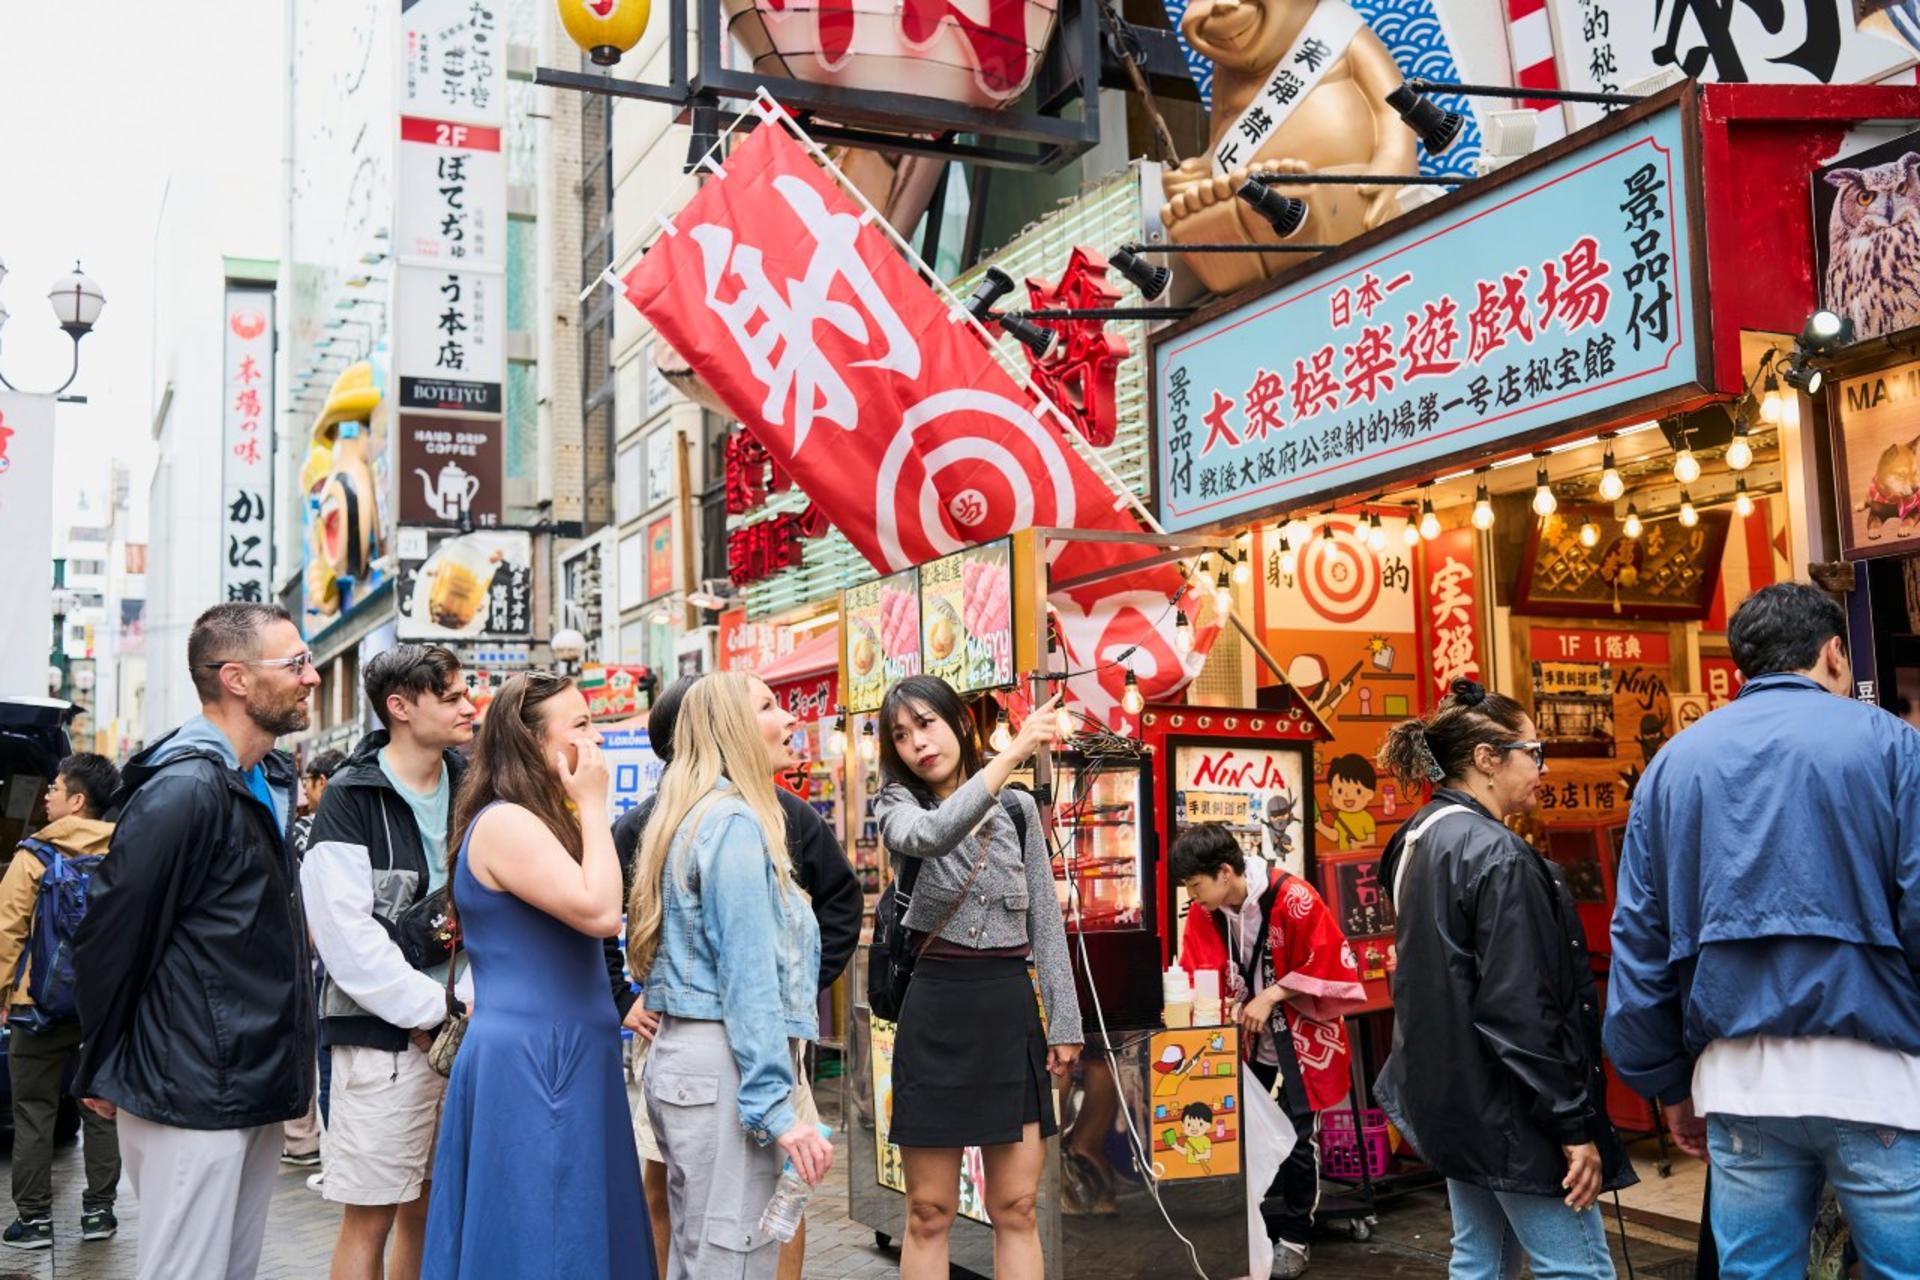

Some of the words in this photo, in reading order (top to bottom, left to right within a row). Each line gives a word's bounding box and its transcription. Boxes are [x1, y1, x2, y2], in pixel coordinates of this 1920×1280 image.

[436, 124, 468, 147] 2F
[1217, 37, 1332, 174] 実弾禁止
[1620, 163, 1672, 351] 景品付
[689, 174, 921, 459] 射
[1331, 273, 1412, 329] 日本一
[1199, 236, 1612, 459] 大衆娯楽遊戯場
[233, 355, 262, 465] 本場の味
[414, 430, 452, 442] HAND
[456, 432, 487, 444] DRIP
[425, 442, 477, 456] COFFEE
[1168, 366, 1193, 498] 景品付
[1199, 333, 1616, 499] 戦後大阪府公認射的場第一号店秘宝館
[1382, 556, 1410, 594] 的
[966, 630, 1009, 662] WAGYU
[1193, 751, 1286, 789] NINJA
